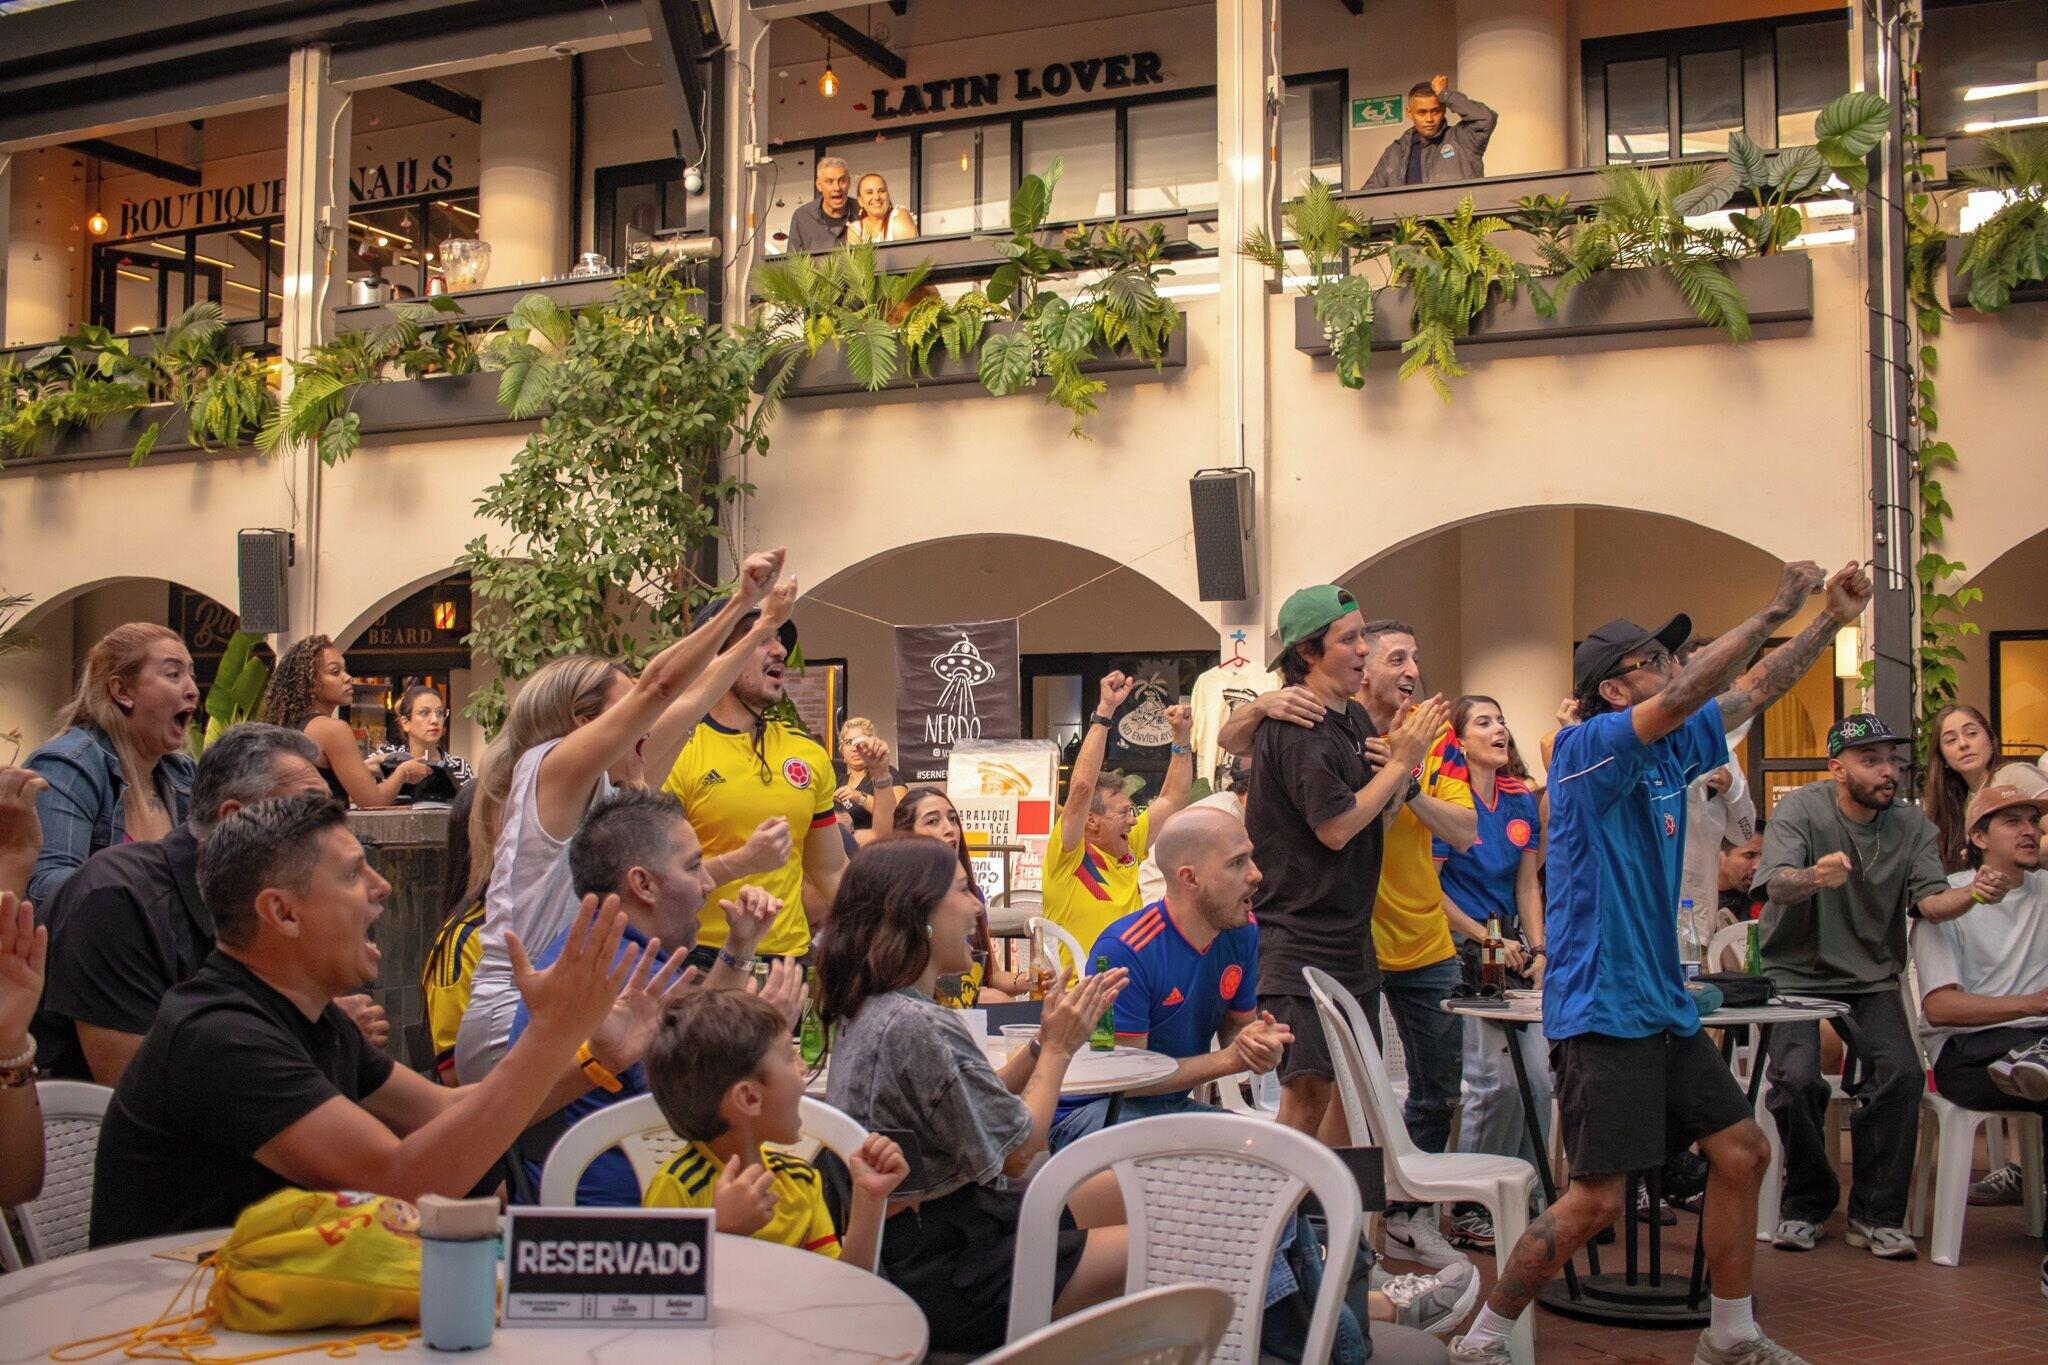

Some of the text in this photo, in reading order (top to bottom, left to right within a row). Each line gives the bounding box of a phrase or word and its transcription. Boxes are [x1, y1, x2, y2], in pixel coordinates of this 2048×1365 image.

[872, 51, 1164, 120] LATIN LOVER
[350, 154, 453, 201] NAILS
[367, 628, 432, 645] BEARD
[924, 713, 981, 744] NERDO
[917, 770, 949, 780] #SERNE
[516, 1239, 701, 1276] RESERVADO
